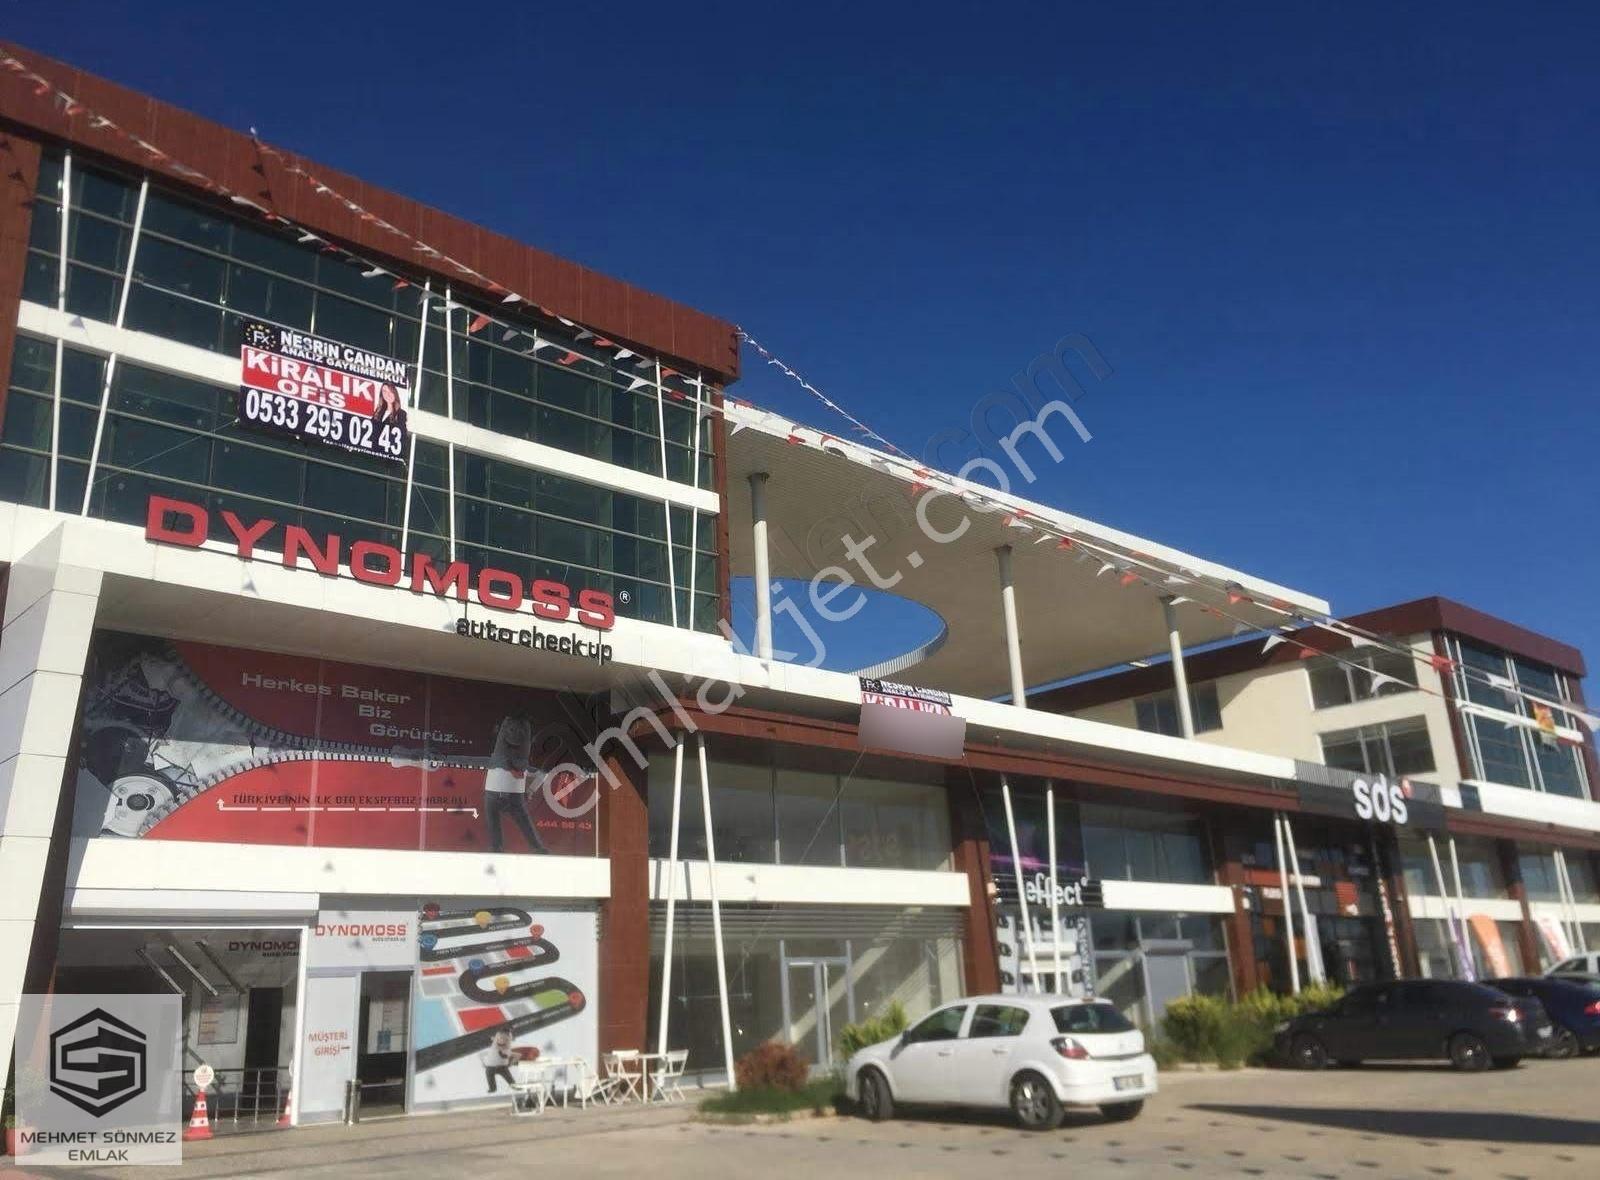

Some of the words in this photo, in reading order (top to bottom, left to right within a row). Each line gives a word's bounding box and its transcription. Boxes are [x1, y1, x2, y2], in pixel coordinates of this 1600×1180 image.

[344, 348, 406, 377] CANDAN
[245, 389, 299, 430] 0533
[305, 405, 344, 440] 295
[350, 416, 373, 448] 02
[378, 424, 402, 456] 43
[145, 495, 615, 630] DYNOMOSS
[456, 617, 513, 644] auto
[242, 673, 332, 696] Herkes
[342, 685, 411, 704] Bakar
[359, 704, 391, 719] Biz
[1353, 773, 1408, 825] sds
[315, 924, 406, 936] DYNOMOSS
[229, 941, 299, 952] DYNOMO
